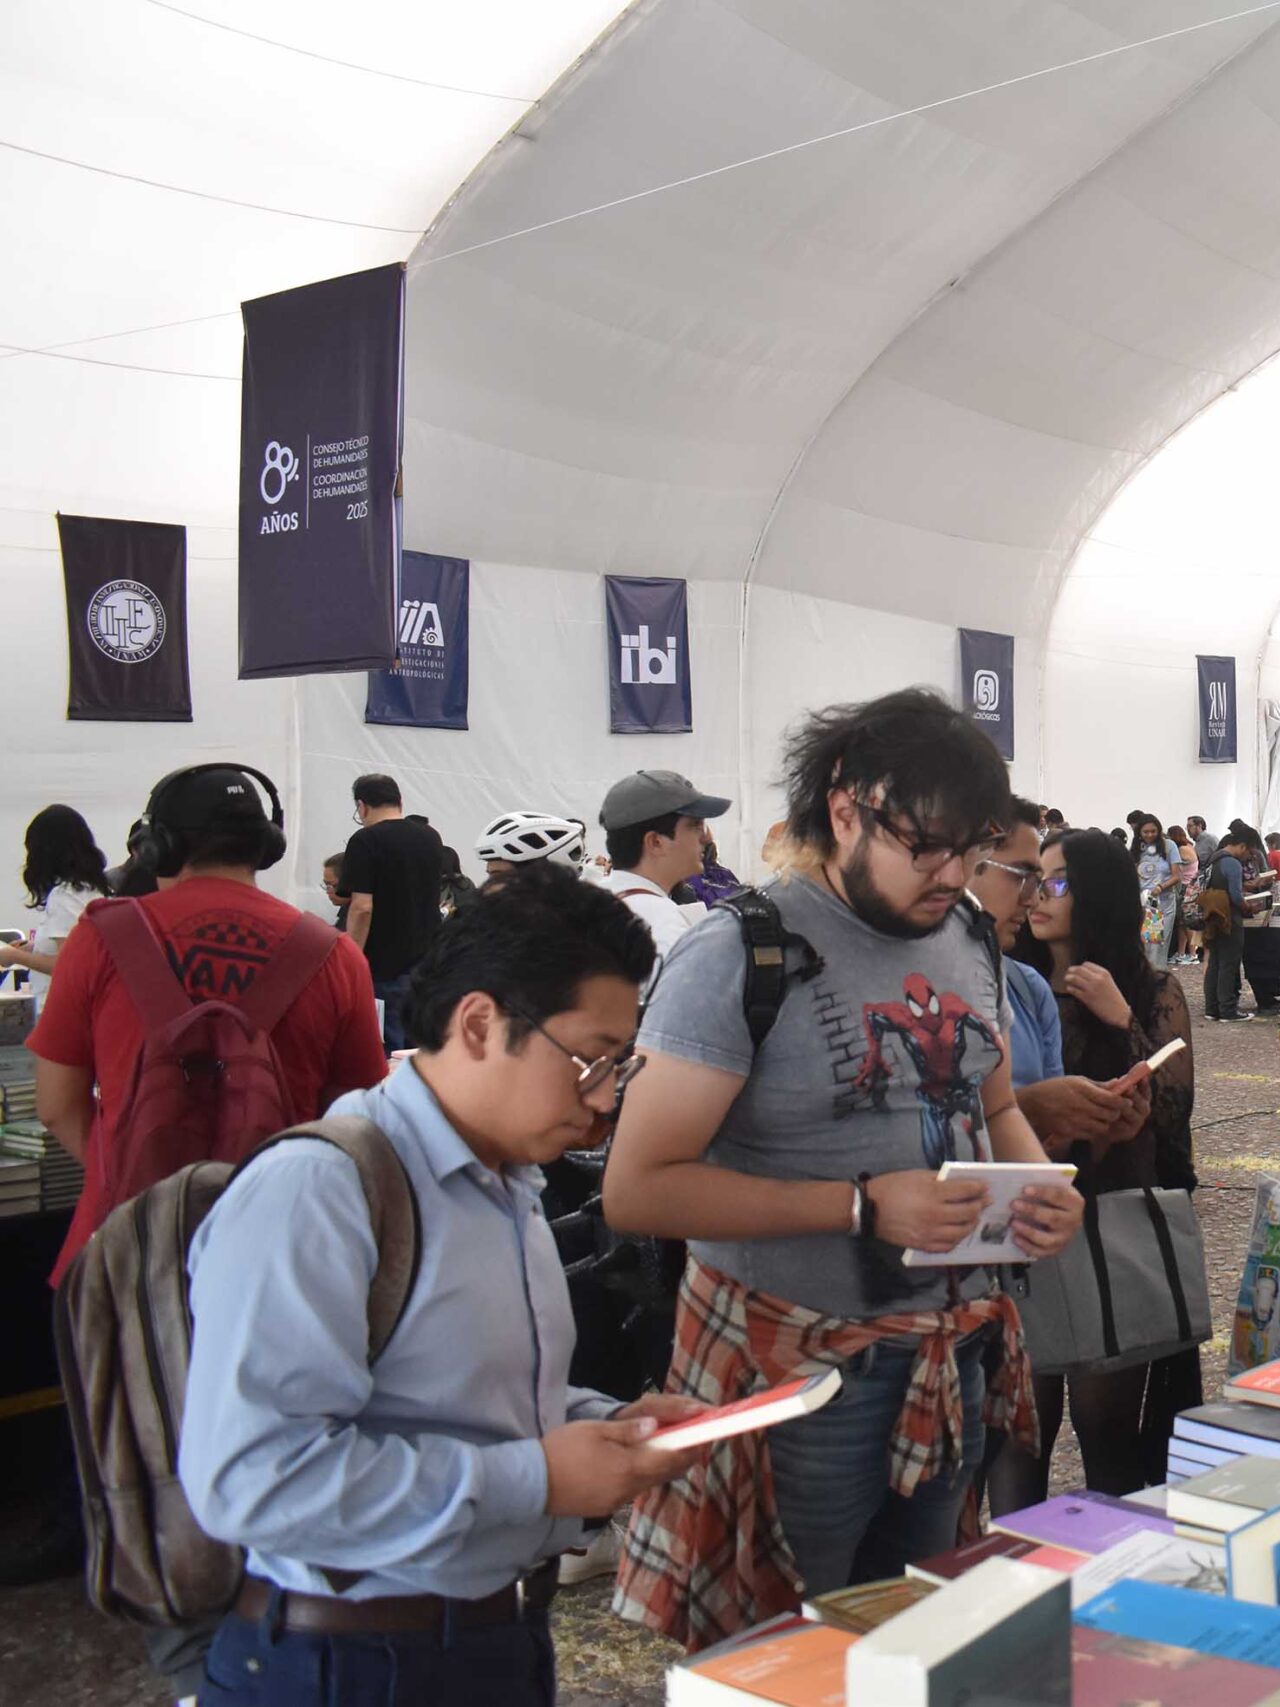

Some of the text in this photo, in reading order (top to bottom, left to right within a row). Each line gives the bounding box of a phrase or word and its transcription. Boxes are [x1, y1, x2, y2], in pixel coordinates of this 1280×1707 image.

[313, 442, 345, 456] CONSEJO
[313, 458, 323, 469] DE
[313, 489, 323, 499] DE
[260, 510, 299, 535] AÑOS
